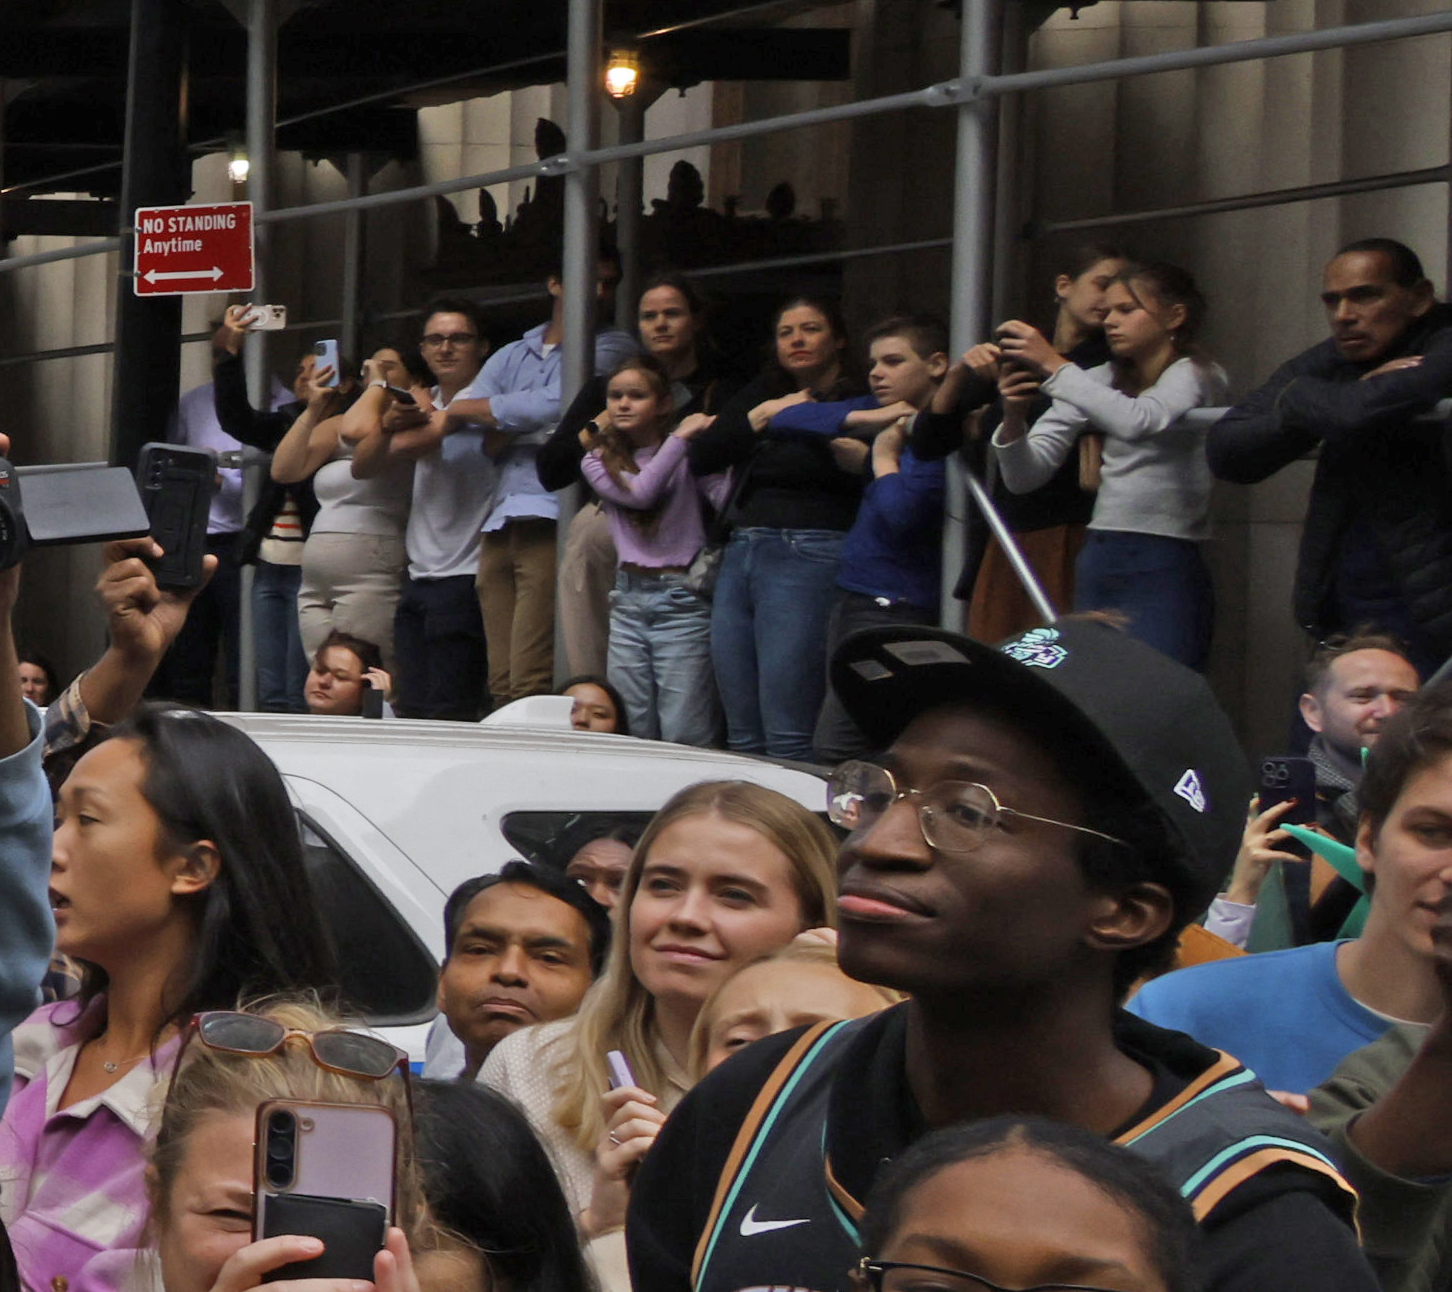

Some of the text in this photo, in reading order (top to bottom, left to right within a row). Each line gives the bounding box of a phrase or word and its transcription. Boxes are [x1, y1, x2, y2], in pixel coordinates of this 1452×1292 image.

[143, 214, 236, 234] NO STANDING
[143, 237, 202, 256] Anytime
